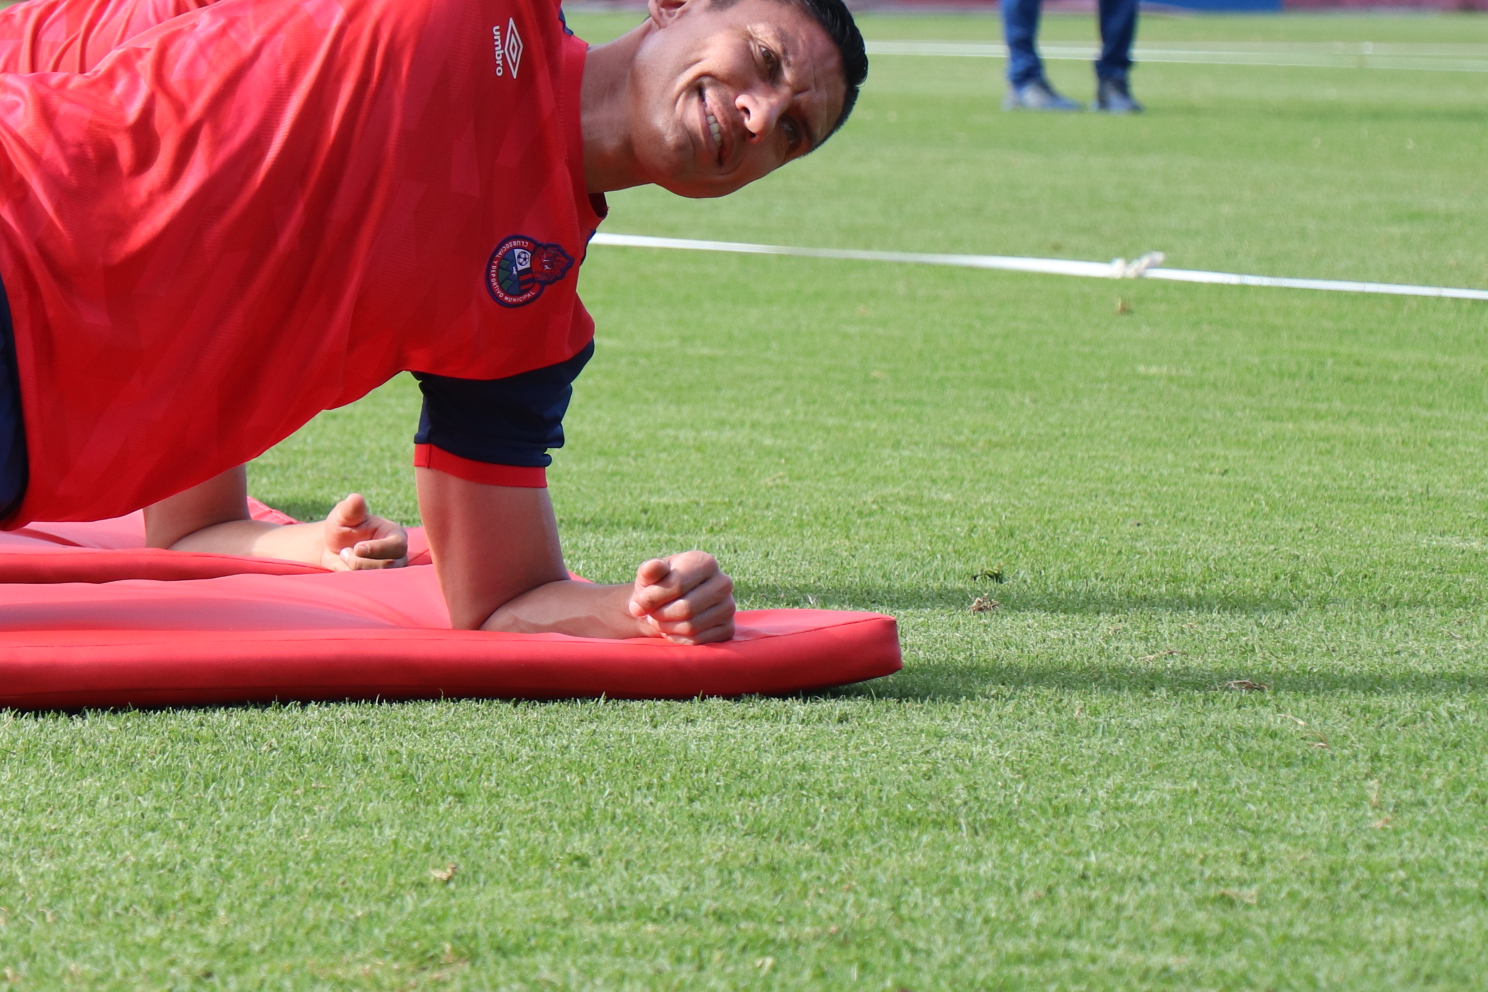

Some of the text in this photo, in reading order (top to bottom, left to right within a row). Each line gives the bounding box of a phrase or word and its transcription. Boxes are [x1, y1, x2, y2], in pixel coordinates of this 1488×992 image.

[492, 25, 503, 77] umbro
[491, 266, 504, 298] DEPORTIVO
[504, 291, 536, 303] MUNICIPAL
